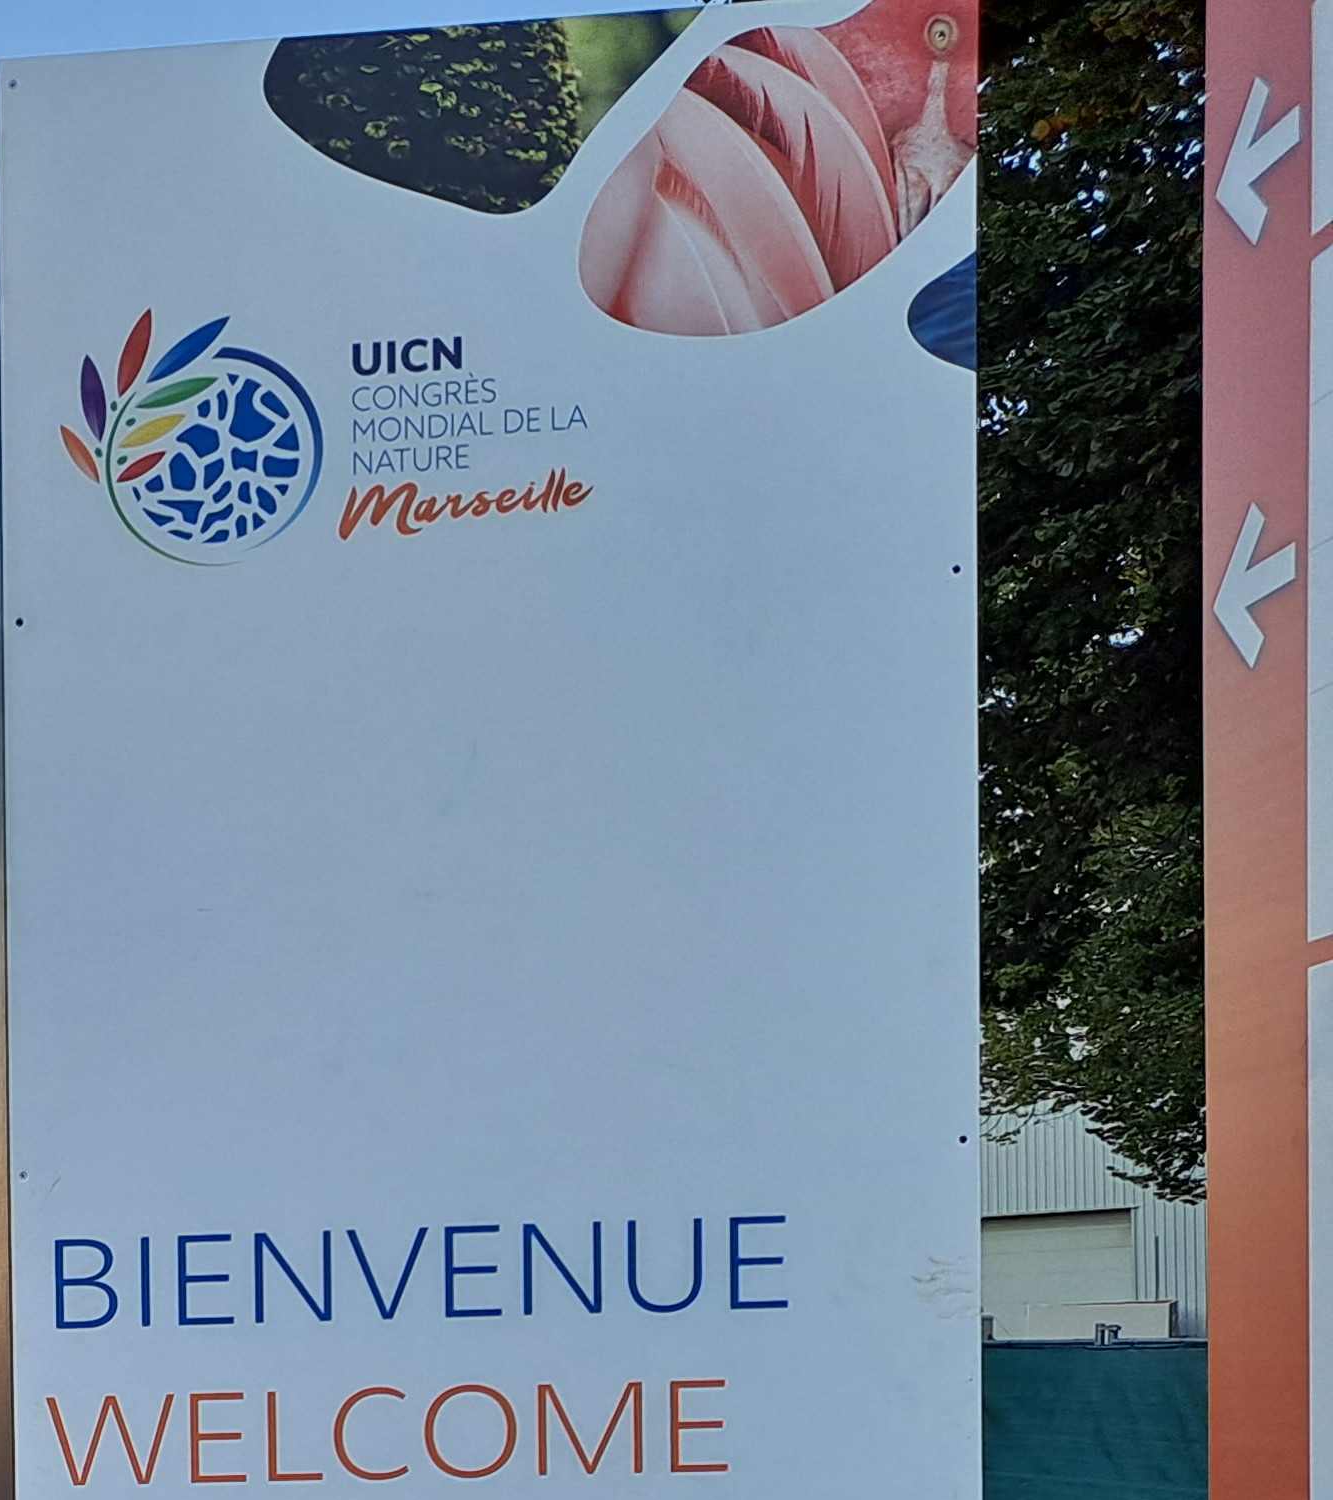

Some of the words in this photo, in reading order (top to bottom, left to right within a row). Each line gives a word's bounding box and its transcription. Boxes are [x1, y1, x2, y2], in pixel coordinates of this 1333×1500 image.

[351, 336, 463, 377] UICN
[351, 372, 497, 412] CONGRÈS
[352, 411, 494, 444] MONDIAL
[503, 406, 541, 434] DE
[551, 404, 588, 431] LA
[352, 444, 470, 476] NATURE
[337, 467, 594, 541] Marseille
[52, 1213, 790, 1331] BIENVENUE
[45, 1377, 730, 1486] WELCOME
